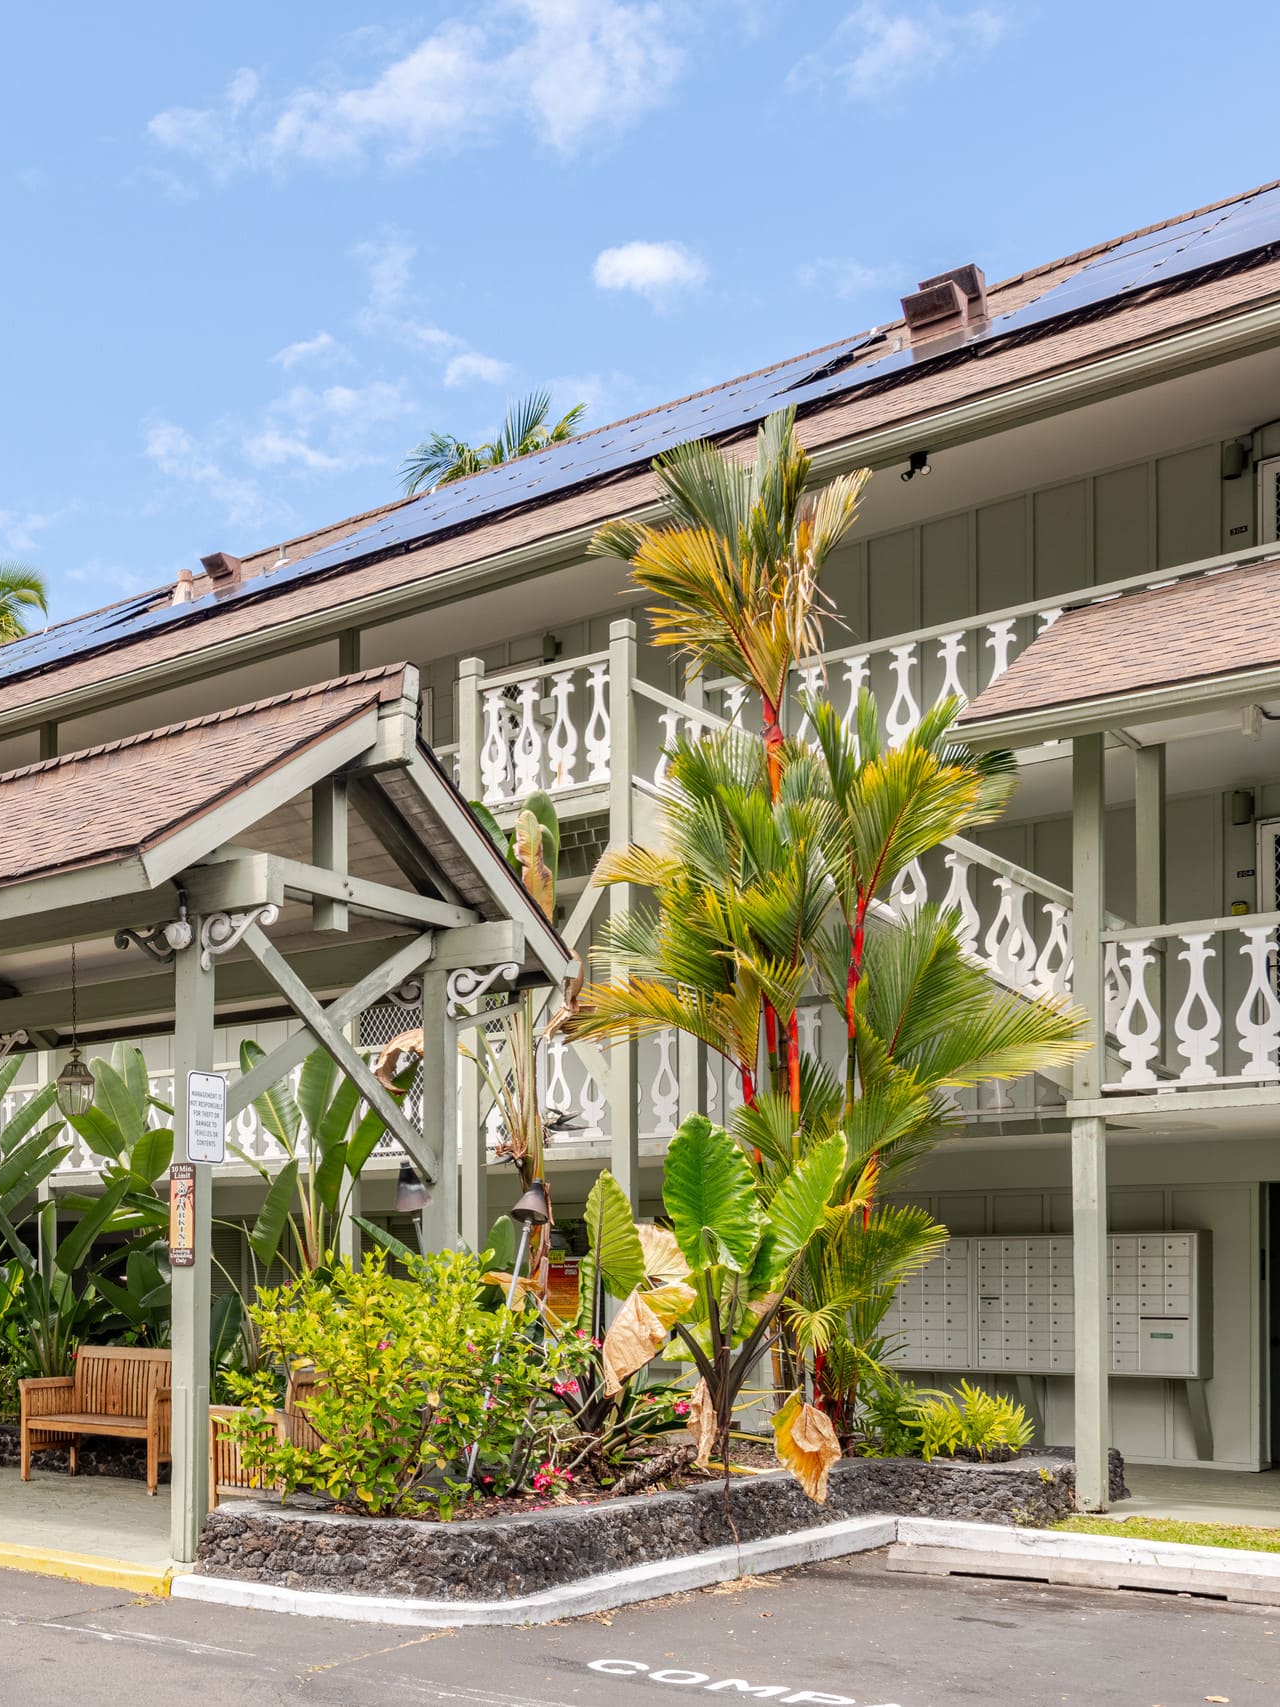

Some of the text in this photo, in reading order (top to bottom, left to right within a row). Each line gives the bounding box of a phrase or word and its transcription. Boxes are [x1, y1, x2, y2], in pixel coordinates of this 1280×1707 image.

[191, 1090, 218, 1099] MANAGEMENT
[198, 1101, 224, 1109] RESPONSIBLE
[195, 1120, 211, 1128] DAMAGE
[196, 1139, 216, 1148] CONTENTS
[171, 1165, 179, 1173] 10
[587, 1659, 902, 1707] COMP
